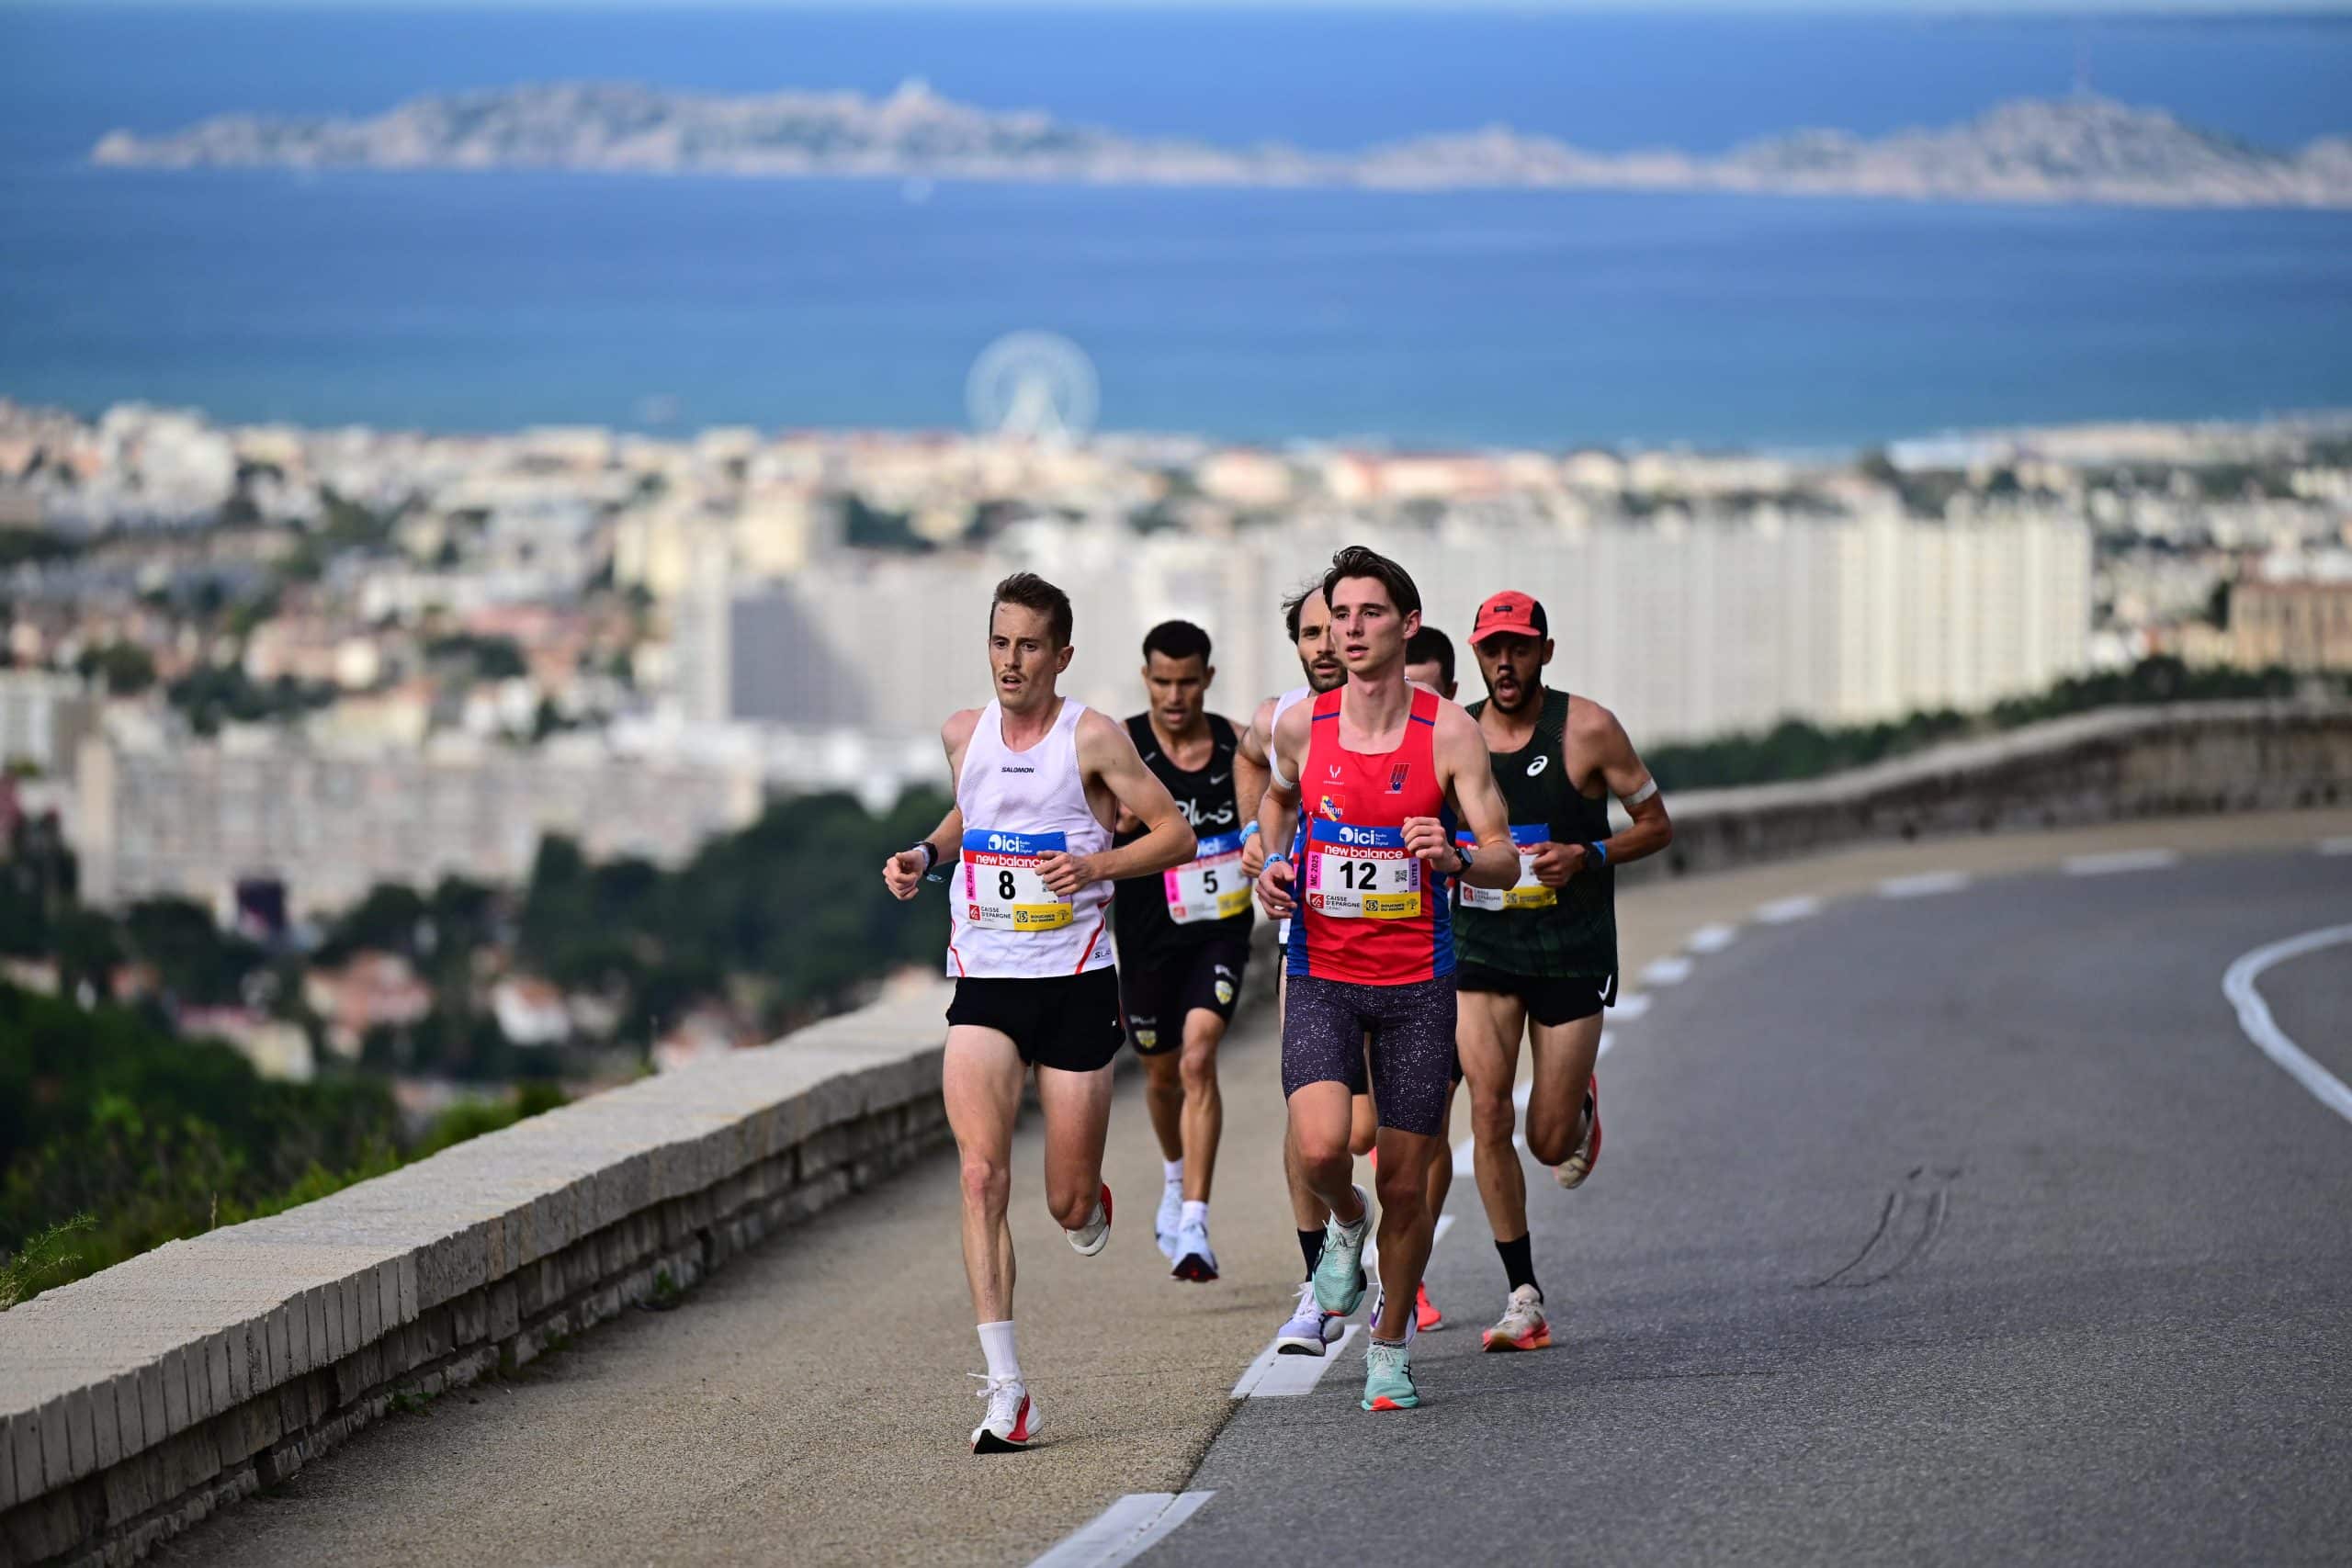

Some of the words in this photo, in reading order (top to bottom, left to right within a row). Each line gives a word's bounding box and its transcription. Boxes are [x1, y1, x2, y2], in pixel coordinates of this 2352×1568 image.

[1001, 834, 1020, 852] ici
[1353, 828, 1375, 846] ici
[976, 854, 998, 865] new
[999, 854, 1045, 868] balanc
[1324, 845, 1349, 856] new
[1350, 846, 1404, 860] balance
[1311, 854, 1319, 873] 2025
[1203, 869, 1218, 895] 5
[1340, 861, 1377, 890] 12
[999, 871, 1016, 900] 8
